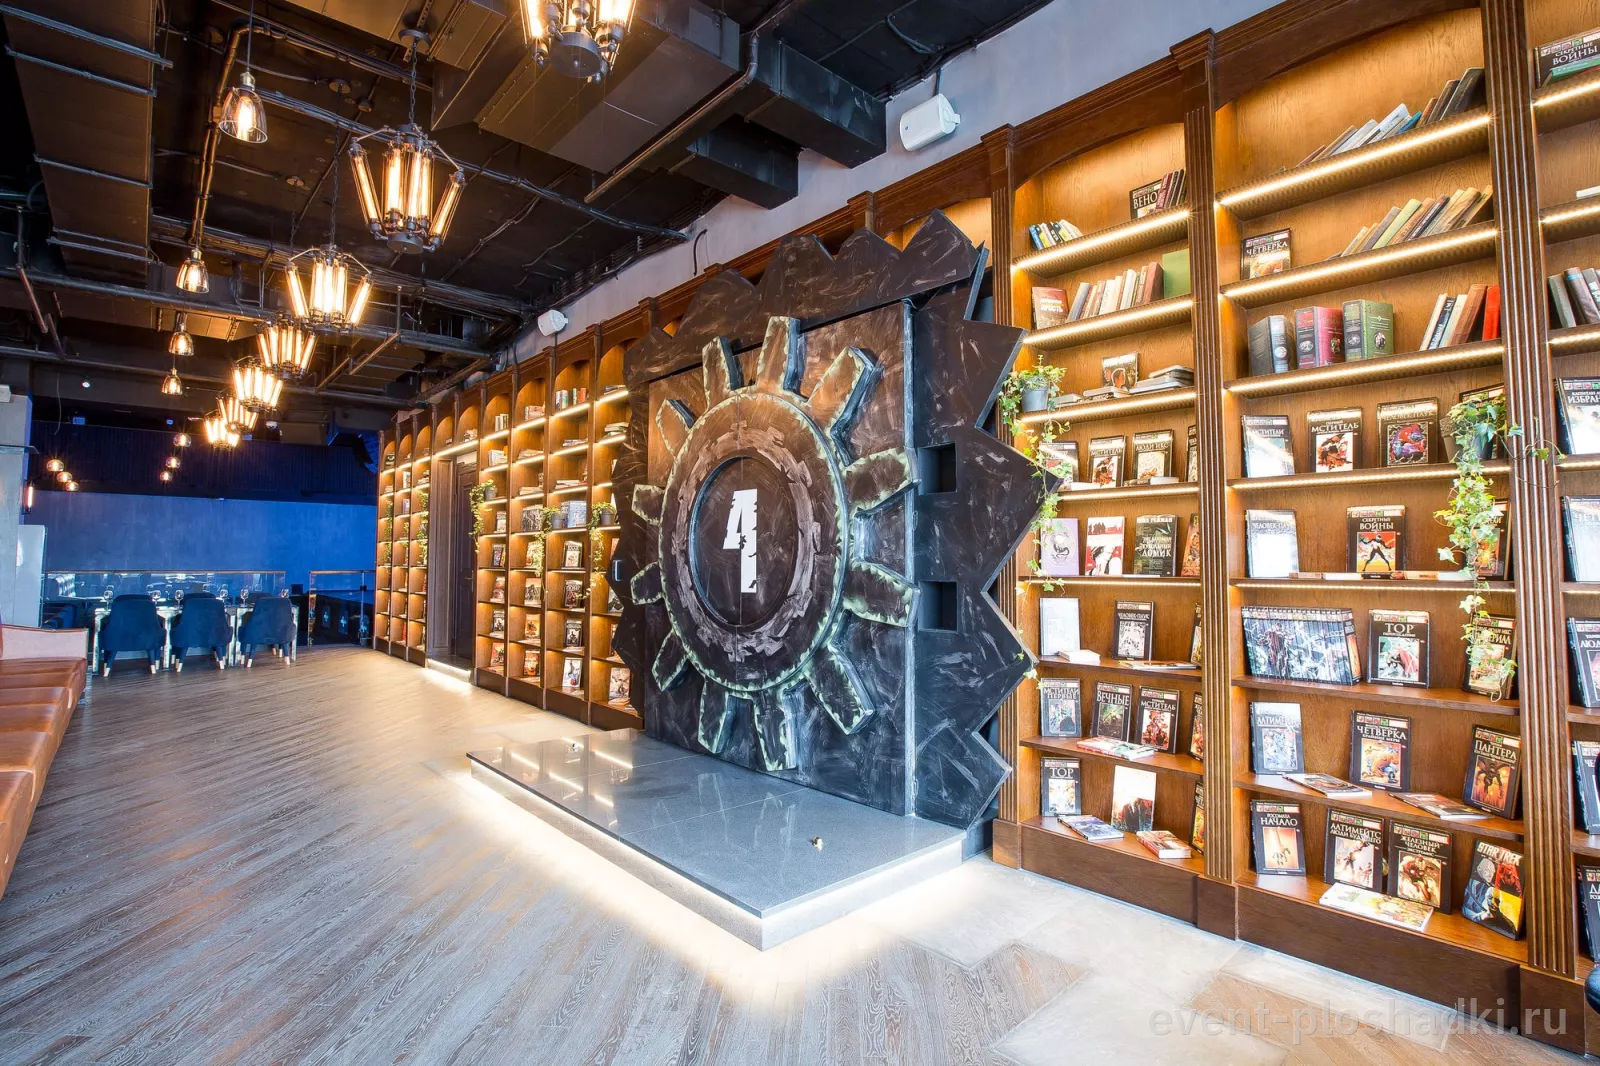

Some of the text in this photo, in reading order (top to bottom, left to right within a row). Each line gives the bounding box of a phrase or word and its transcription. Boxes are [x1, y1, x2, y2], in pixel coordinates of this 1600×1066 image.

[1552, 45, 1598, 65] ВОЙНЫ
[1133, 191, 1158, 209] ВЕНО
[1311, 423, 1359, 433] МСТИТЕЛЬ
[1360, 521, 1394, 530] ВОЙНЫ
[1141, 549, 1172, 557] ДОМИК
[1385, 622, 1415, 634] ТОР
[1043, 687, 1079, 695] МСТИТЕЛИ
[1096, 690, 1130, 706] ВЕЧНЫЕ
[1140, 700, 1176, 711] МСТИТЕЛЬ
[1356, 725, 1407, 740] ЧЕТВЕРКА
[1474, 739, 1517, 760] ПАНТЕРА
[1050, 767, 1075, 778] ТОР
[1260, 817, 1298, 826] НАЧАЛО
[1330, 822, 1382, 839] АЛТИМЕЙТС
[1400, 835, 1441, 849] ЖЕЛЕЗНЫЙ
[1405, 841, 1437, 853] ЧЕЛОВЕК
[1476, 841, 1524, 867] STAR TREK
